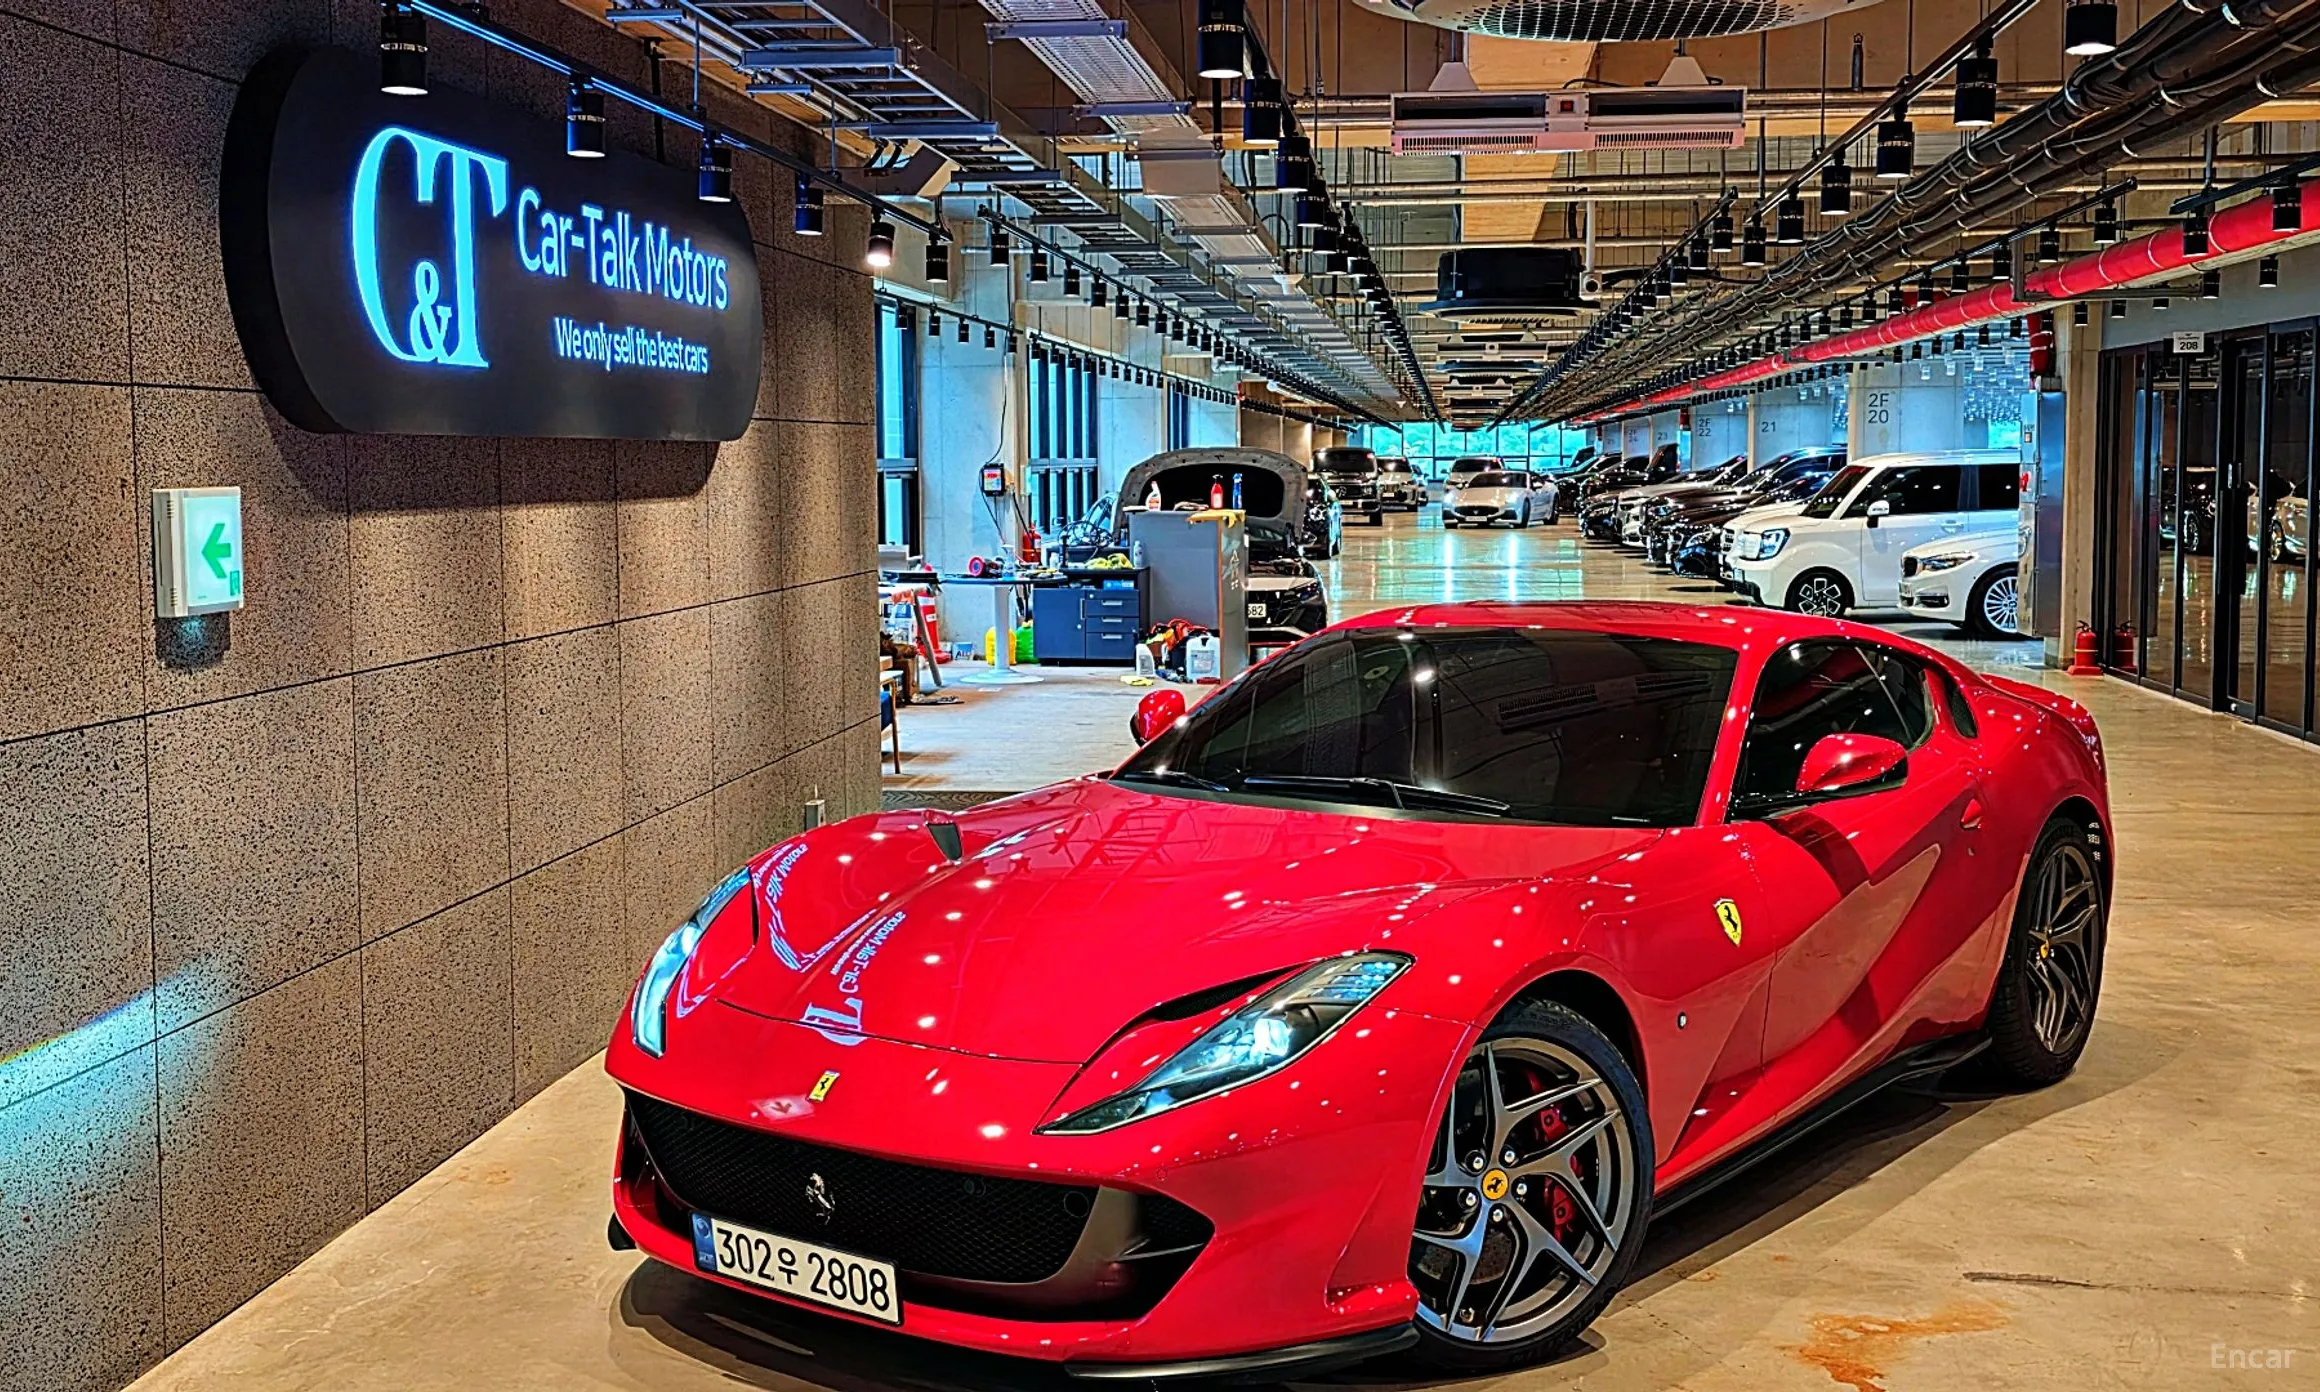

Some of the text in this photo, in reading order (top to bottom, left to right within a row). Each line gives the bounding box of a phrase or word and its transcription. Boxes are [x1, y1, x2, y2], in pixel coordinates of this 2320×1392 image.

[518, 188, 729, 310] Car-Talk Motors
[554, 316, 708, 374] We only sell the best cars
[2180, 341, 2198, 351] 208
[1868, 393, 1889, 408] 2F
[1698, 418, 1711, 428] 2F
[1868, 409, 1889, 424] 20
[1698, 428, 1712, 438] 22
[1761, 422, 1777, 433] 21
[1657, 431, 1668, 441] 23
[716, 1227, 890, 1312] 302우 2808
